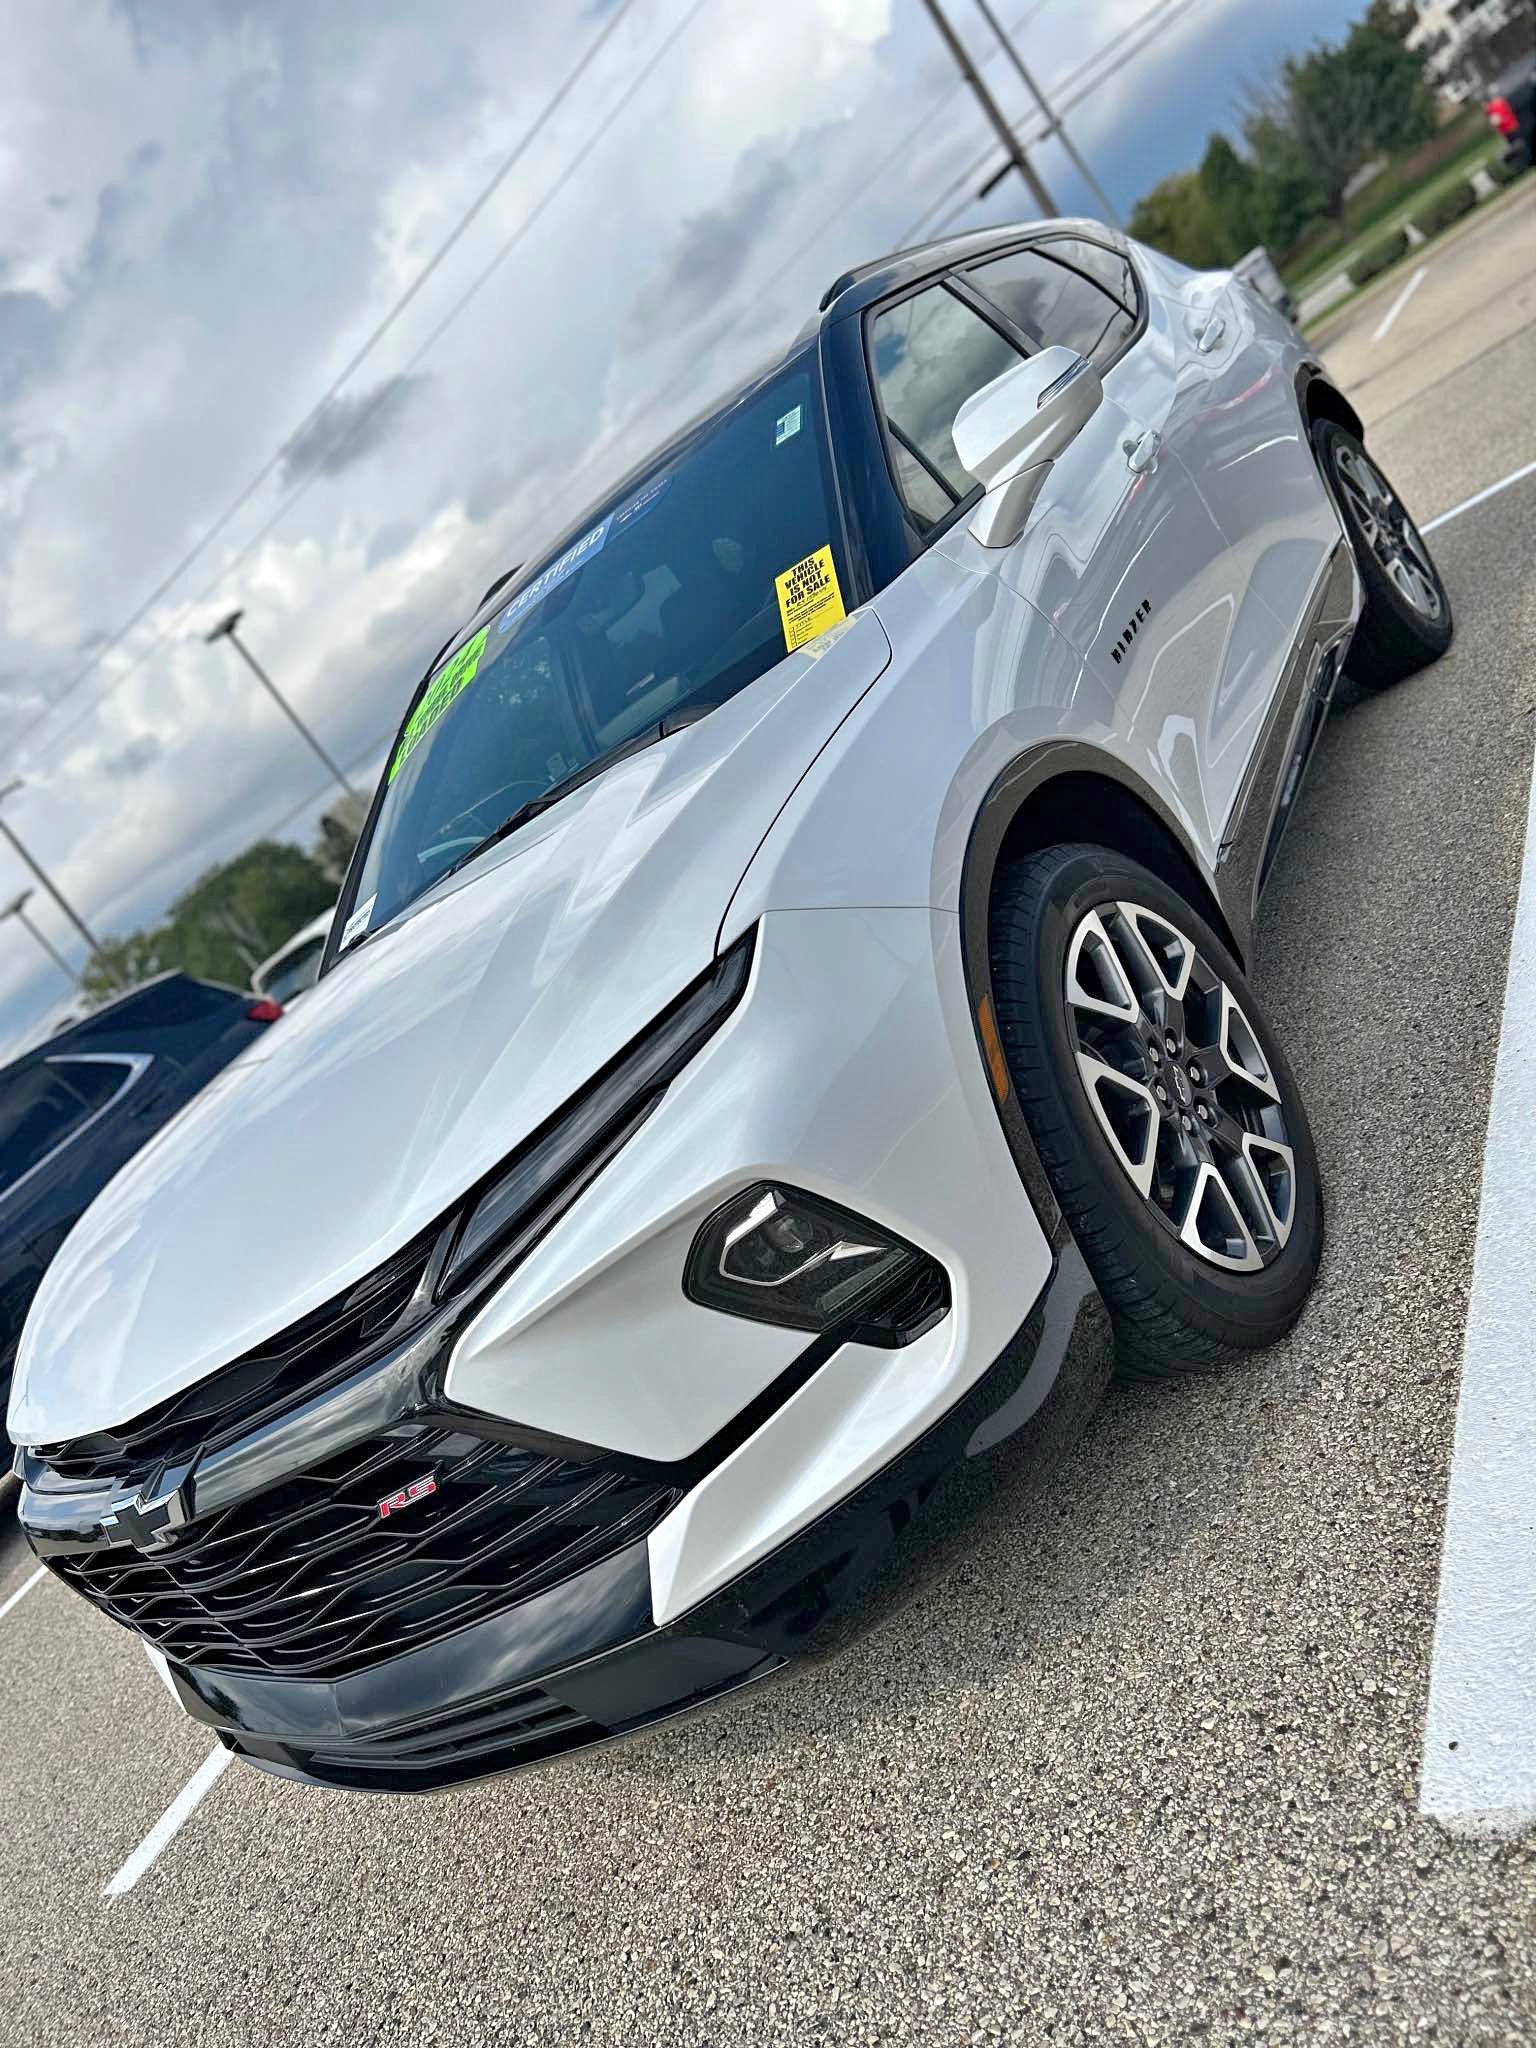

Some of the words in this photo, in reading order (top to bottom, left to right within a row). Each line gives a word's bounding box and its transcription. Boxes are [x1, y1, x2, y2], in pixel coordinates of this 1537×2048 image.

[507, 527, 604, 617] CERTIFIED
[785, 559, 824, 589] VEHICLE
[789, 584, 800, 596] IS
[802, 570, 821, 588] NOT
[792, 557, 814, 576] THIS
[786, 591, 804, 608] FOR
[806, 574, 830, 595] SALE
[1111, 599, 1151, 664] BLAZER
[379, 1475, 436, 1519] RS
